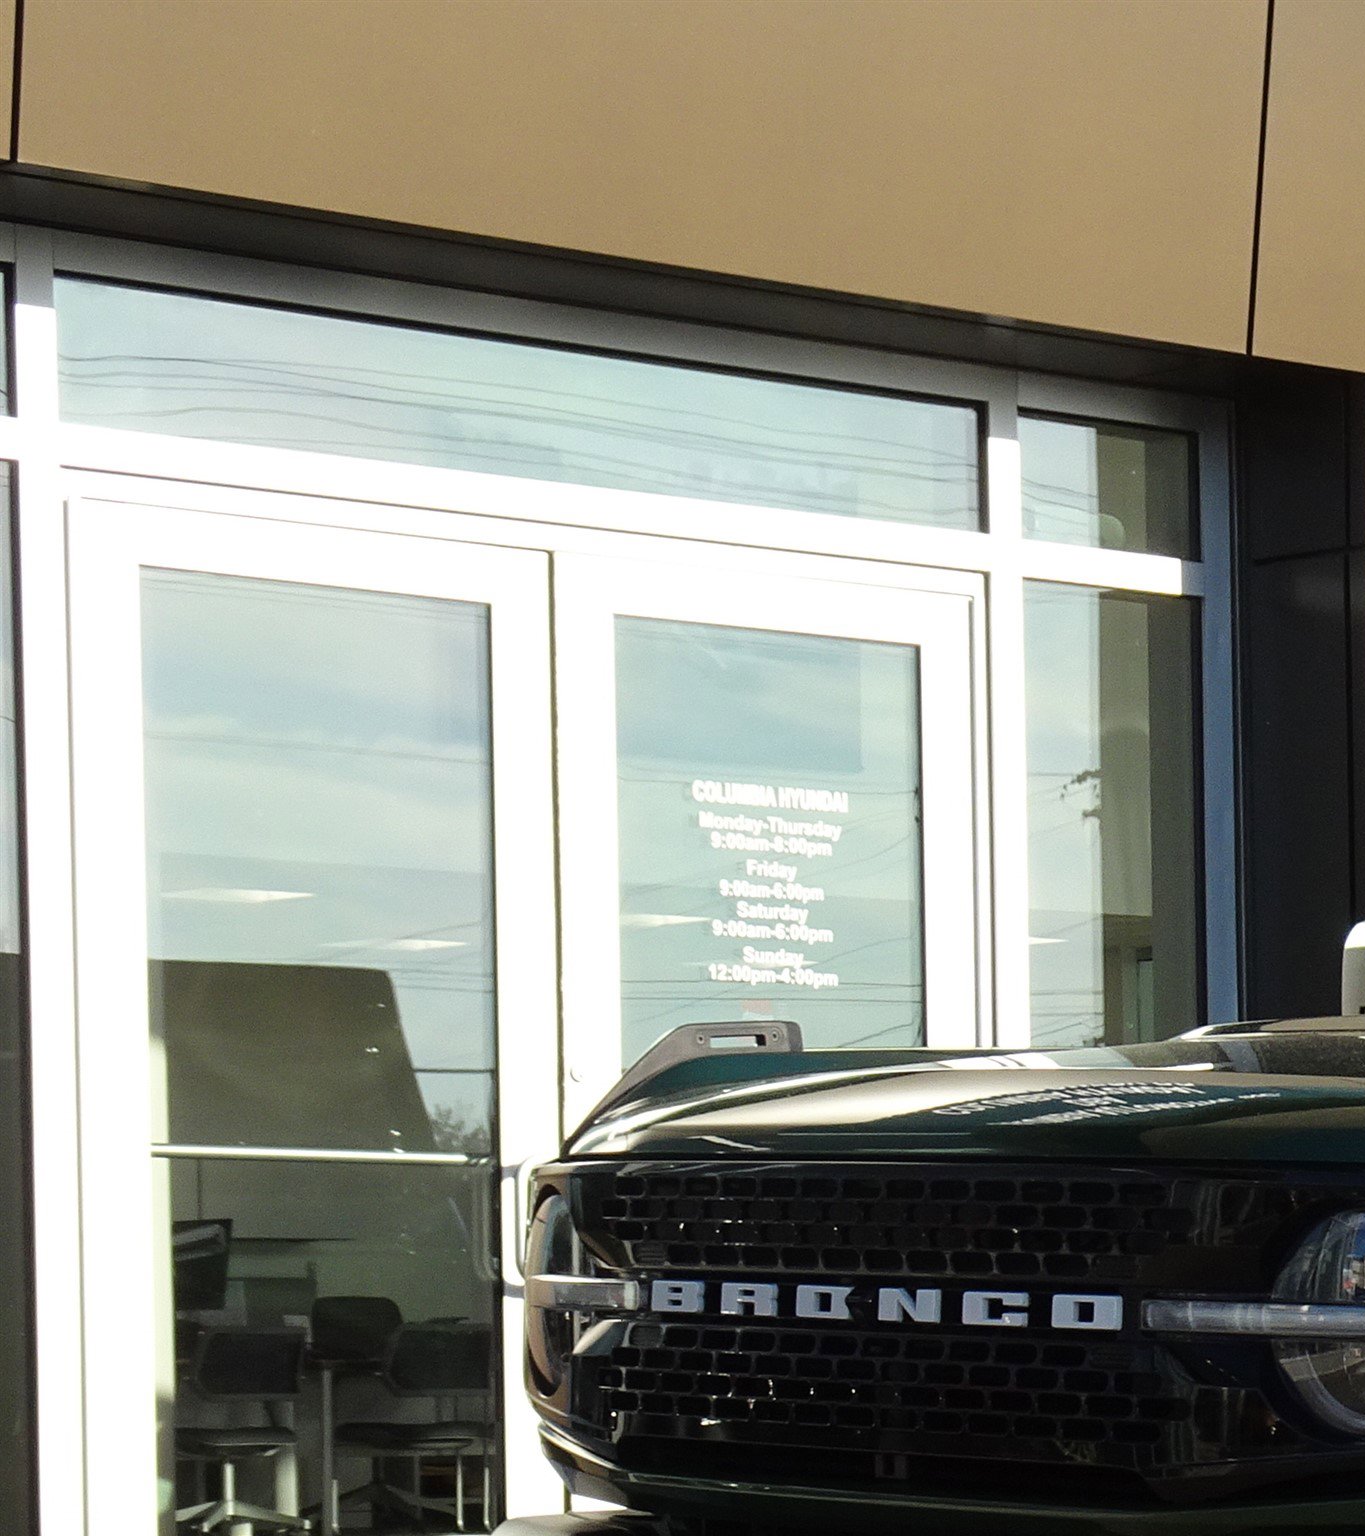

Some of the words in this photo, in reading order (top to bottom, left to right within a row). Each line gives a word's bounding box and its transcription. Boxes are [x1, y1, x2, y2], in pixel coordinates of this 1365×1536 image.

[692, 779, 778, 808] COLUMBIA
[778, 786, 849, 813] HYUNDAI
[699, 810, 842, 842] Monday-Thursday
[746, 858, 797, 883] Friday
[736, 900, 809, 925] Saturday
[742, 945, 805, 969] Sunday
[708, 963, 839, 990] 12:00pm-4:00pm
[651, 1279, 1123, 1331] BRONCO
